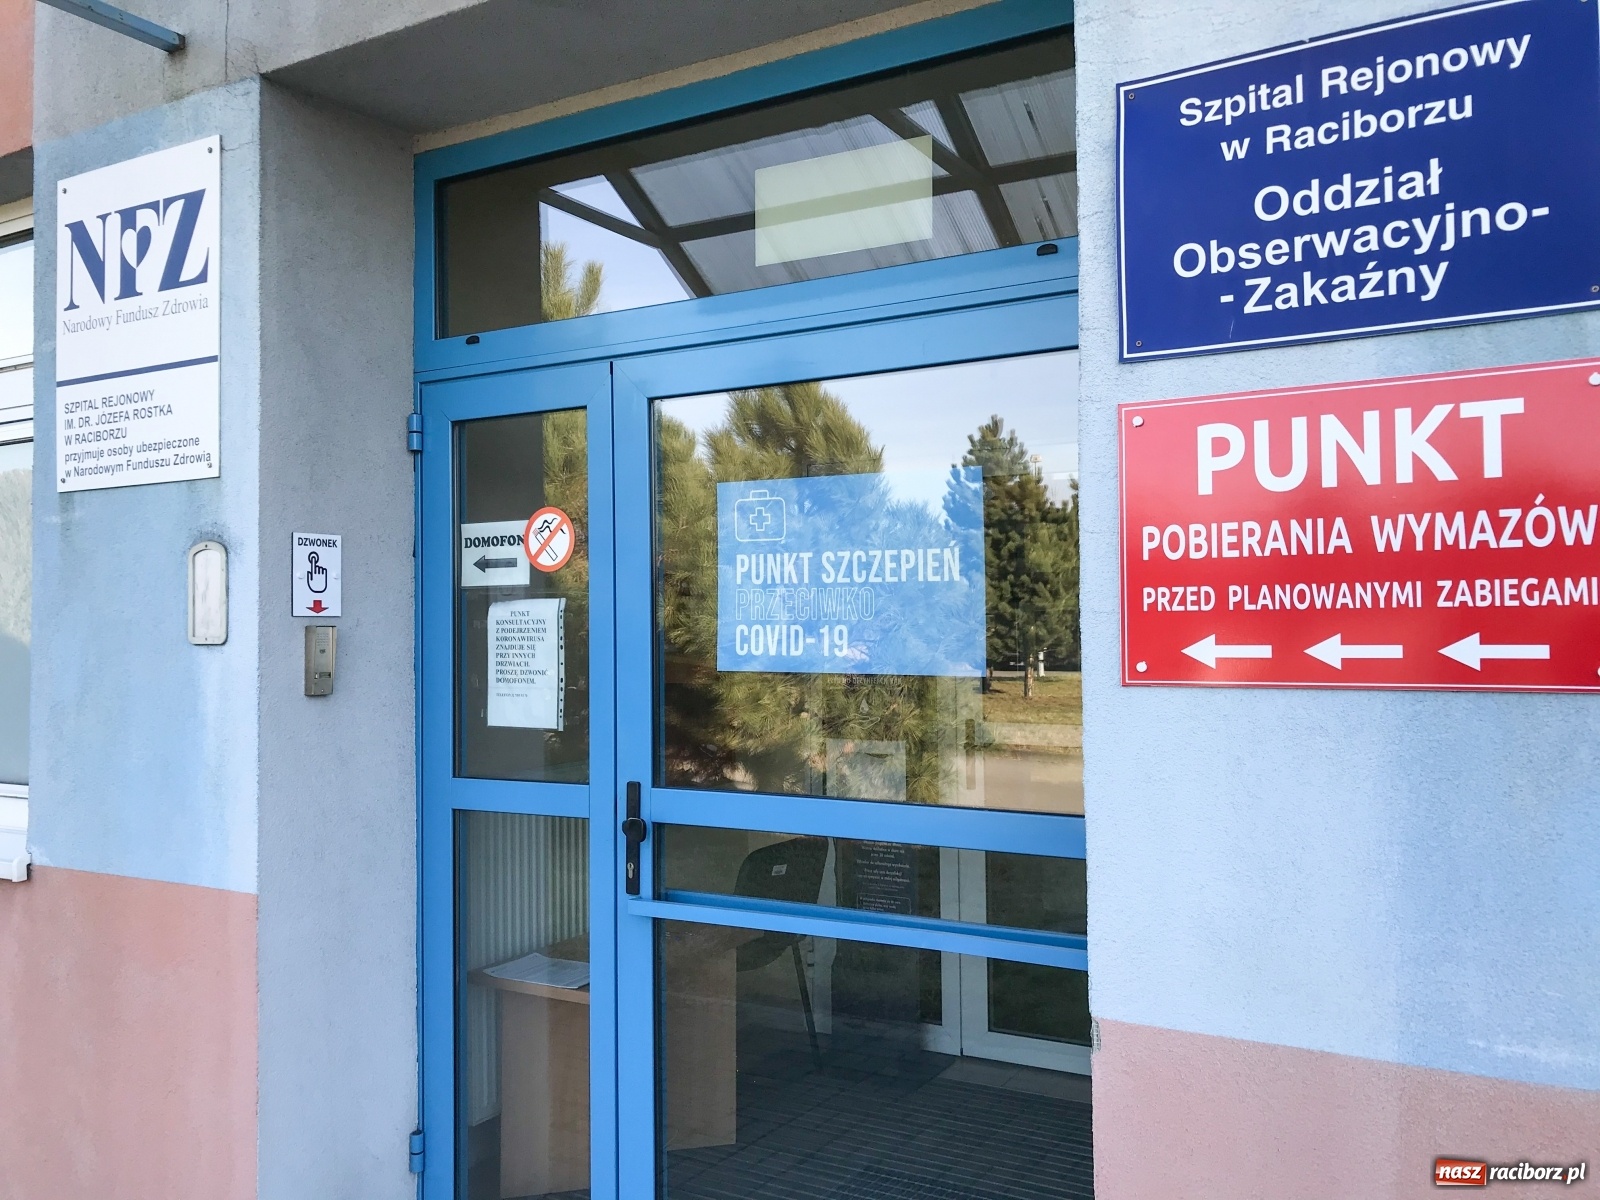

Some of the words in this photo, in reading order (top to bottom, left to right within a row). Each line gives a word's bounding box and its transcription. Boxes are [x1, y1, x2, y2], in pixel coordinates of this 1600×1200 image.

[1179, 74, 1304, 127] Szpital
[1320, 33, 1532, 99] Rejonowy
[1220, 136, 1251, 162] w
[1265, 94, 1474, 155] Raciborzu
[1253, 157, 1443, 222] Oddział
[64, 188, 210, 312] NFZ
[1173, 200, 1550, 279] Obserwacyjno-
[63, 314, 113, 335] Narodowy
[116, 305, 159, 325] Fundusz
[162, 293, 209, 317] Zdrowia
[64, 399, 99, 415] SZPITAL
[101, 389, 155, 409] REJONOWY
[64, 417, 76, 431] IM.
[78, 415, 93, 428] DR.
[95, 410, 130, 426] JÓZEFA
[133, 404, 173, 421] ROSTKA
[64, 435, 73, 446] W
[75, 427, 127, 445] RACIBORZU
[64, 447, 105, 465] przyjmuje
[107, 443, 134, 457] osoby
[136, 436, 200, 454] ubezpieczone
[1196, 397, 1525, 496] PUNKT
[65, 468, 72, 478] w
[74, 462, 124, 478] Narodowym
[126, 456, 171, 472] Funduszu
[173, 451, 211, 466] Zdrowia
[297, 537, 338, 549] DZWONEK
[464, 534, 525, 549] DOMOFON
[1141, 516, 1353, 561] POBIERANIA
[1370, 493, 1599, 553] WYMAZÓW
[735, 552, 813, 585] PUNKT
[821, 541, 961, 584] SZCZEPIEŃ
[735, 586, 876, 621] PRZECIWKO
[1142, 584, 1216, 612] PRZED
[1228, 580, 1422, 612] PLANOWANYMI
[1436, 576, 1599, 608] ZABIEGAMI
[526, 644, 536, 652] SIĘ
[735, 624, 849, 657] COVID-19
[496, 669, 519, 677] PROSZĘ
